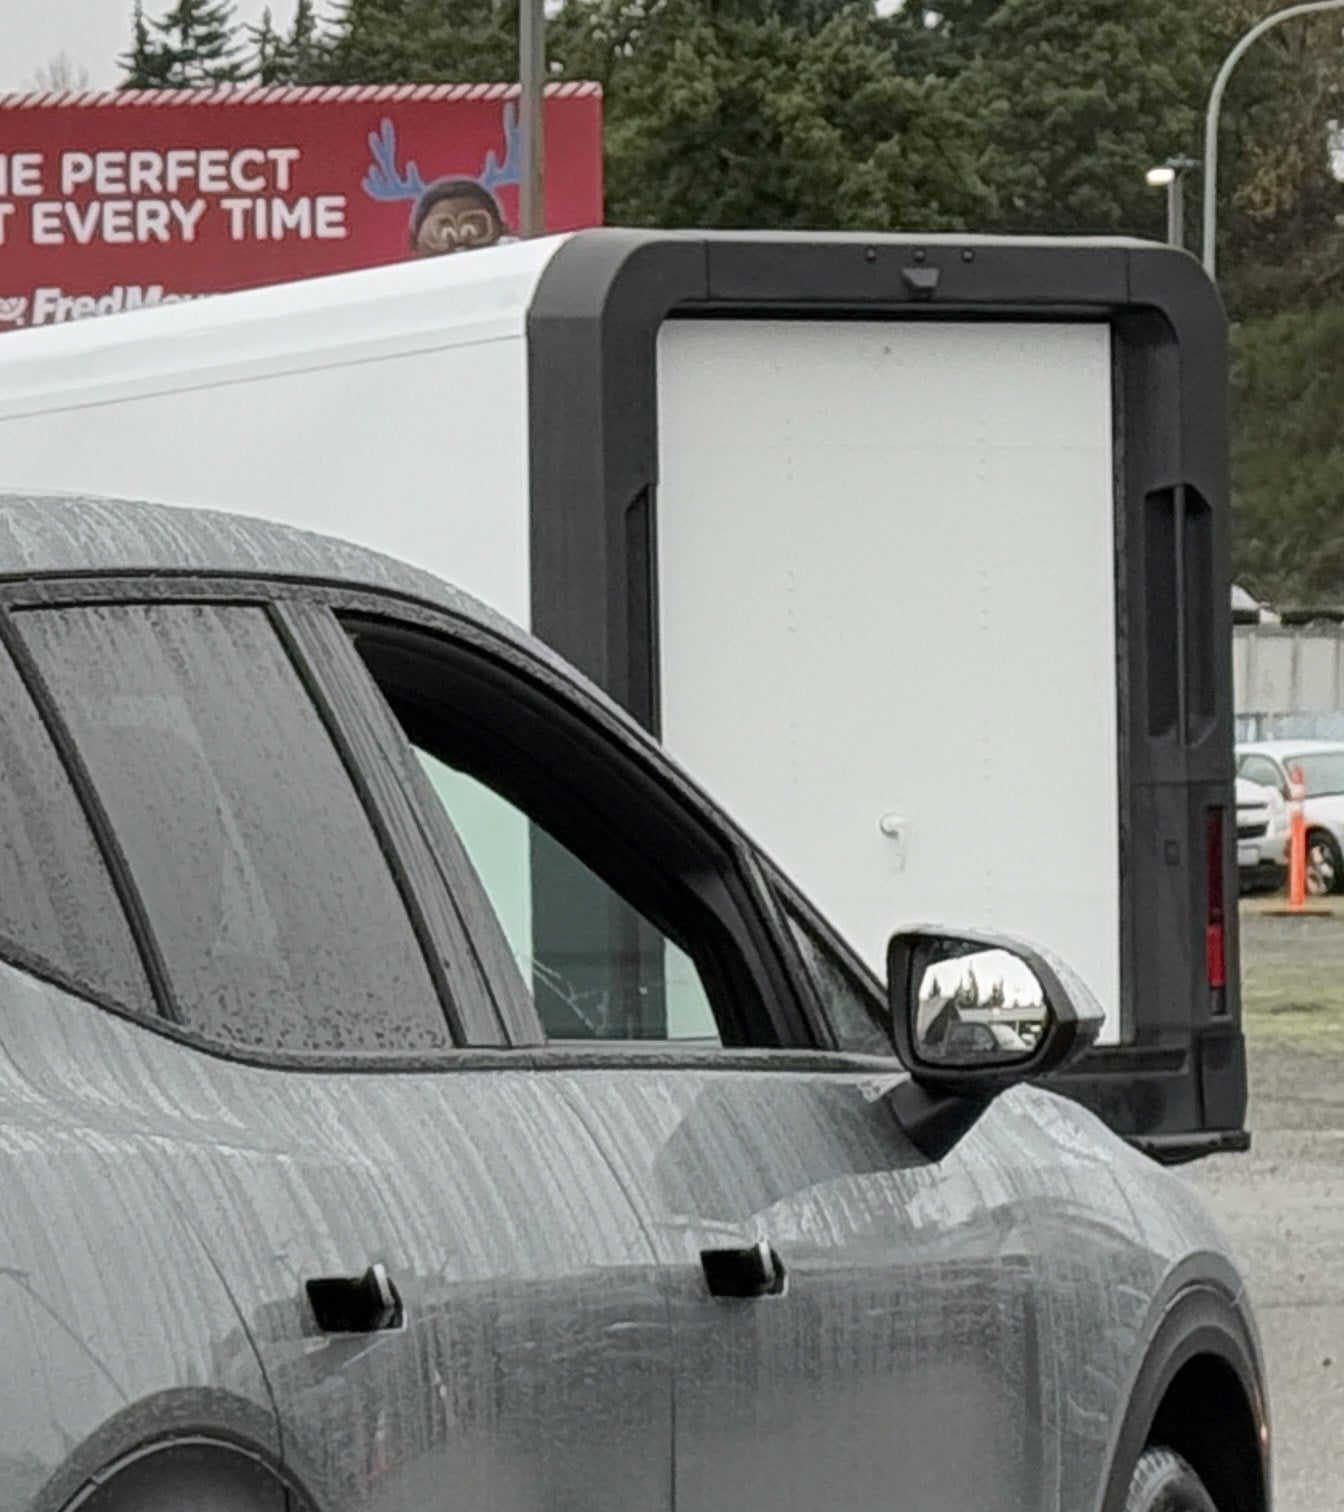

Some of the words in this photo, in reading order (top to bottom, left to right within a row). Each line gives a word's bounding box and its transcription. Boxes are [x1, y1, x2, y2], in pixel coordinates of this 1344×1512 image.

[60, 148, 301, 196] PERFECT
[31, 199, 207, 245] EVERY
[220, 195, 348, 241] TIME
